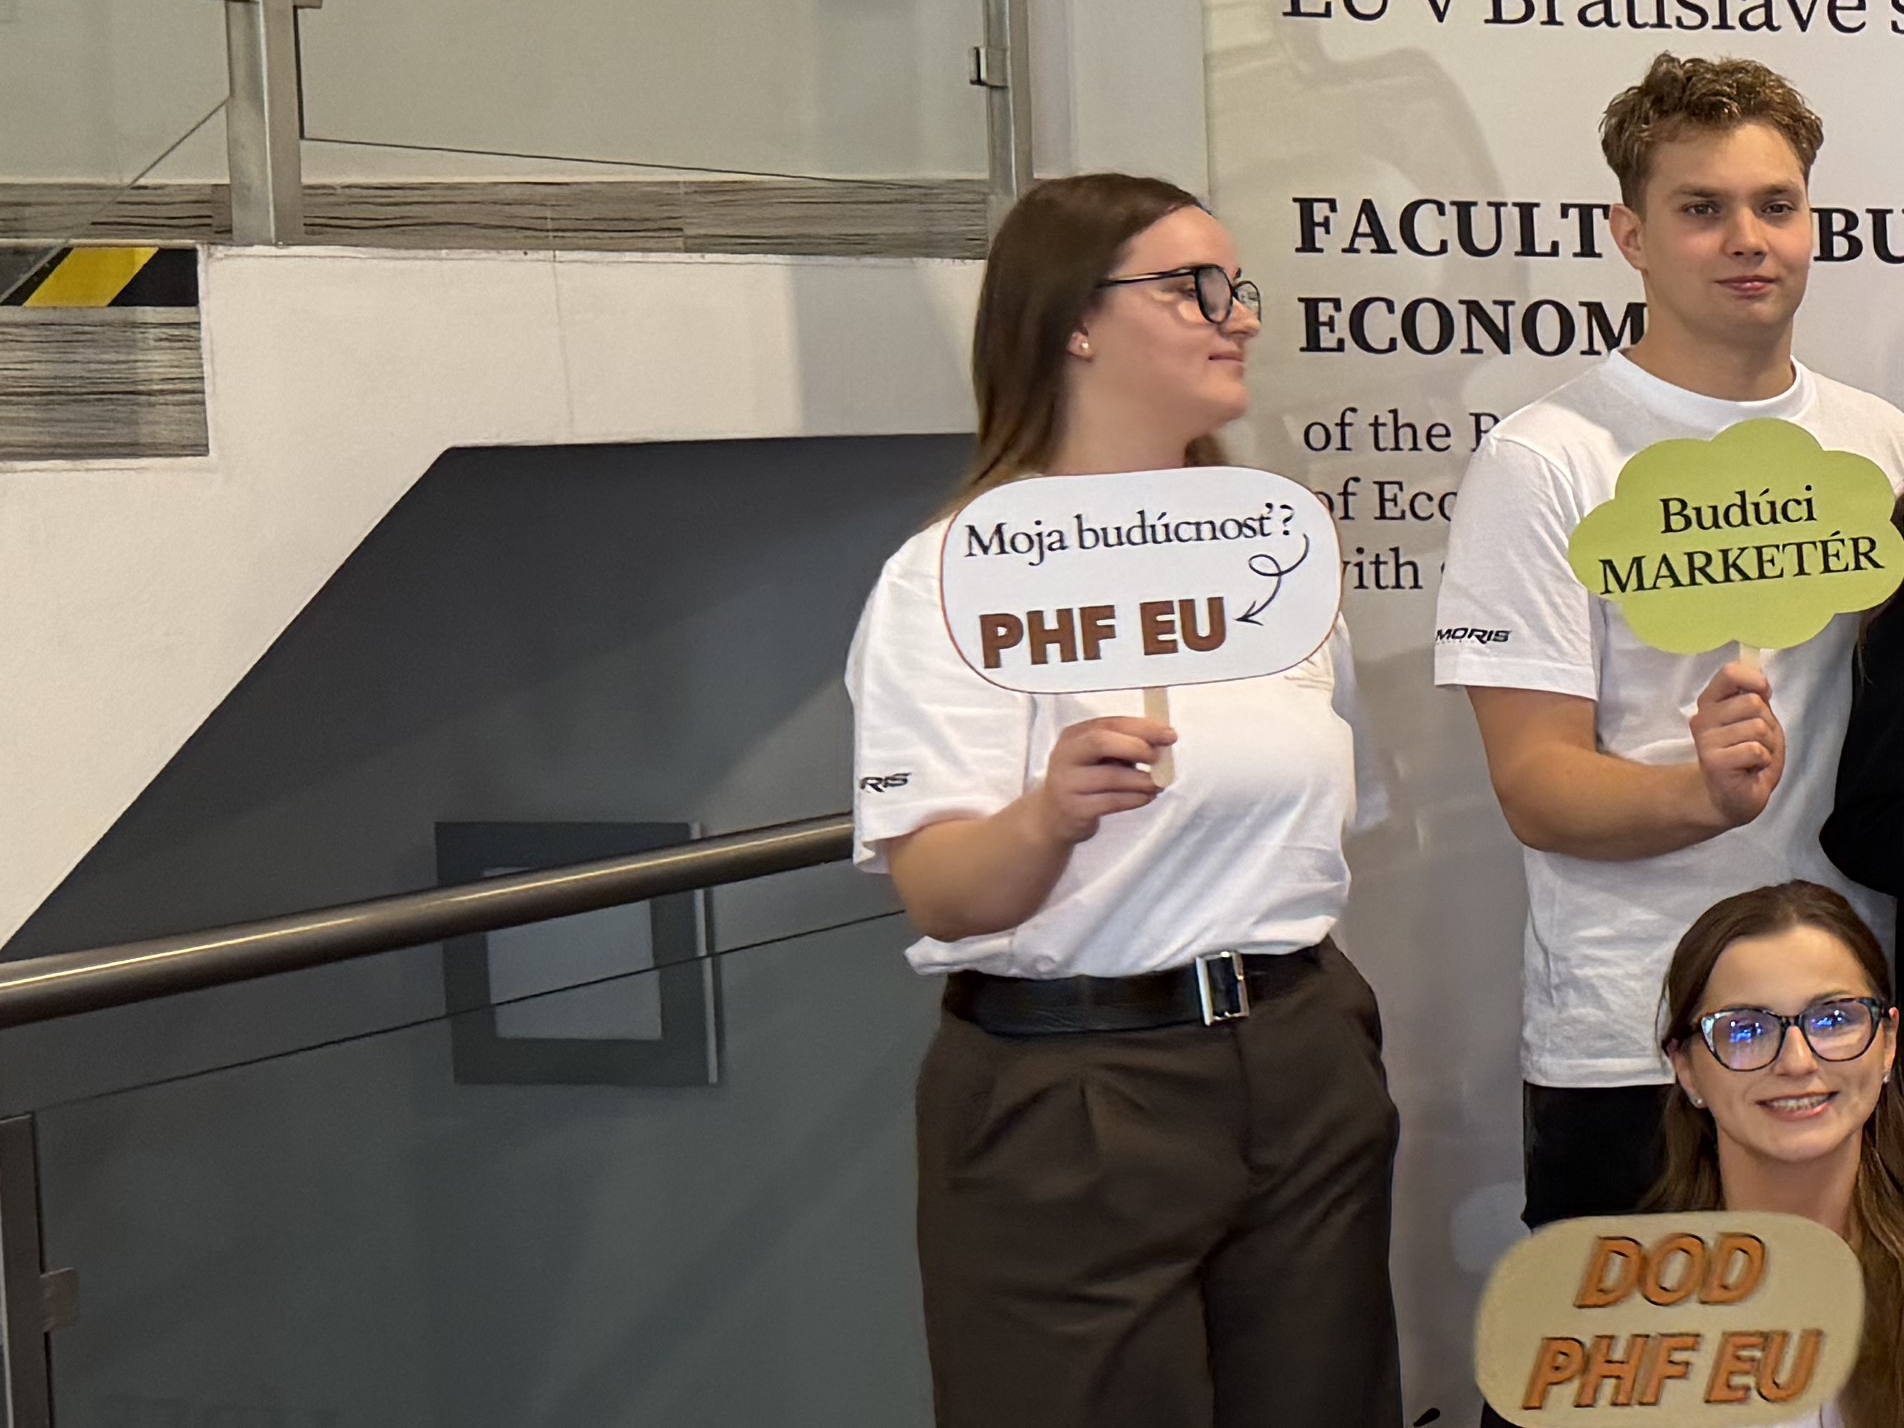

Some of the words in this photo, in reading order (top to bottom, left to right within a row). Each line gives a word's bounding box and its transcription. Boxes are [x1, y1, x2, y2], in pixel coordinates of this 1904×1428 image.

[1292, 196, 1611, 259] FACULT
[1297, 295, 1649, 357] ECONOM
[1303, 407, 1359, 452] of
[1368, 408, 1452, 453] the
[1659, 484, 1817, 535] Budúci
[965, 521, 1069, 568] Moja
[1598, 530, 1886, 596] MARKETÉR
[979, 603, 1117, 670] PHF
[1139, 595, 1228, 657] EU
[1573, 1232, 1767, 1309] DOD
[1521, 1332, 1703, 1411] PHF
[1704, 1328, 1825, 1405] EU
